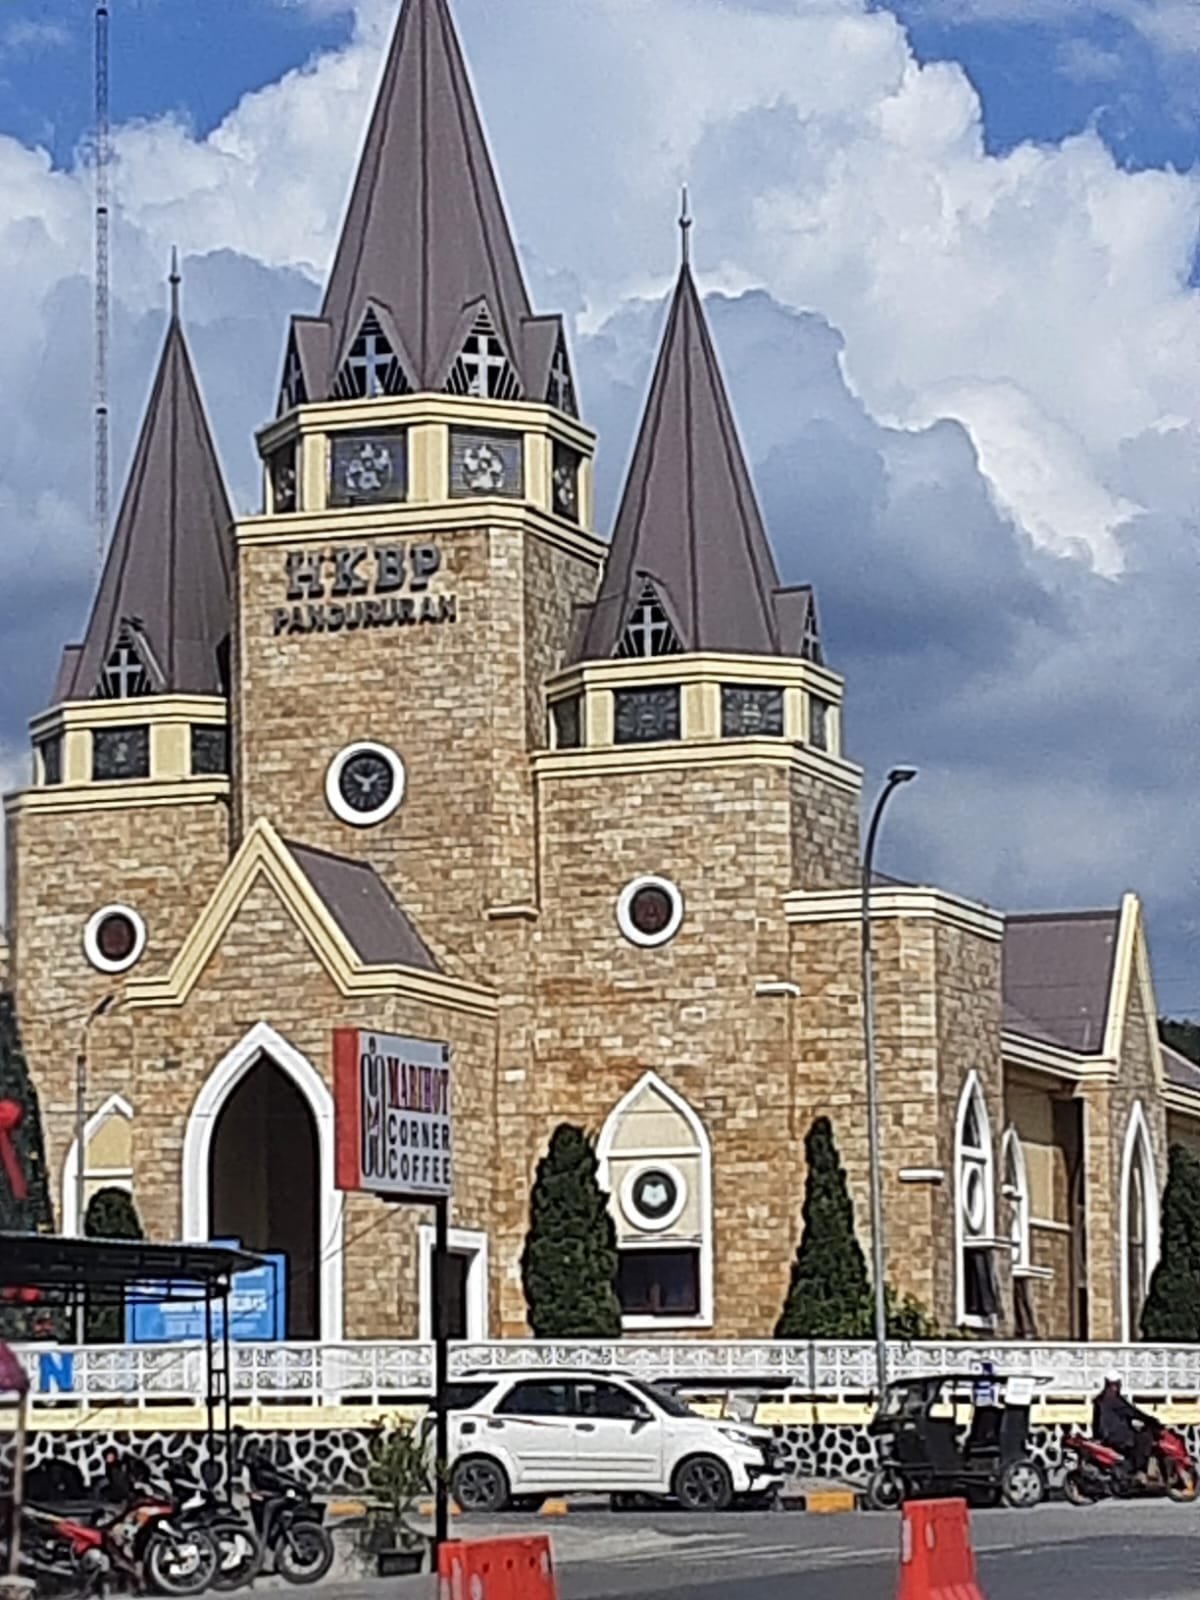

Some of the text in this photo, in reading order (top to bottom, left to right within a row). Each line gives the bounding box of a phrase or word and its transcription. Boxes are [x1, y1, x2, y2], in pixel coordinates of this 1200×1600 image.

[287, 543, 442, 600] HKBP
[388, 1114, 450, 1150] CORNER
[388, 1148, 451, 1185] COFFEE
[39, 1352, 74, 1392] N
